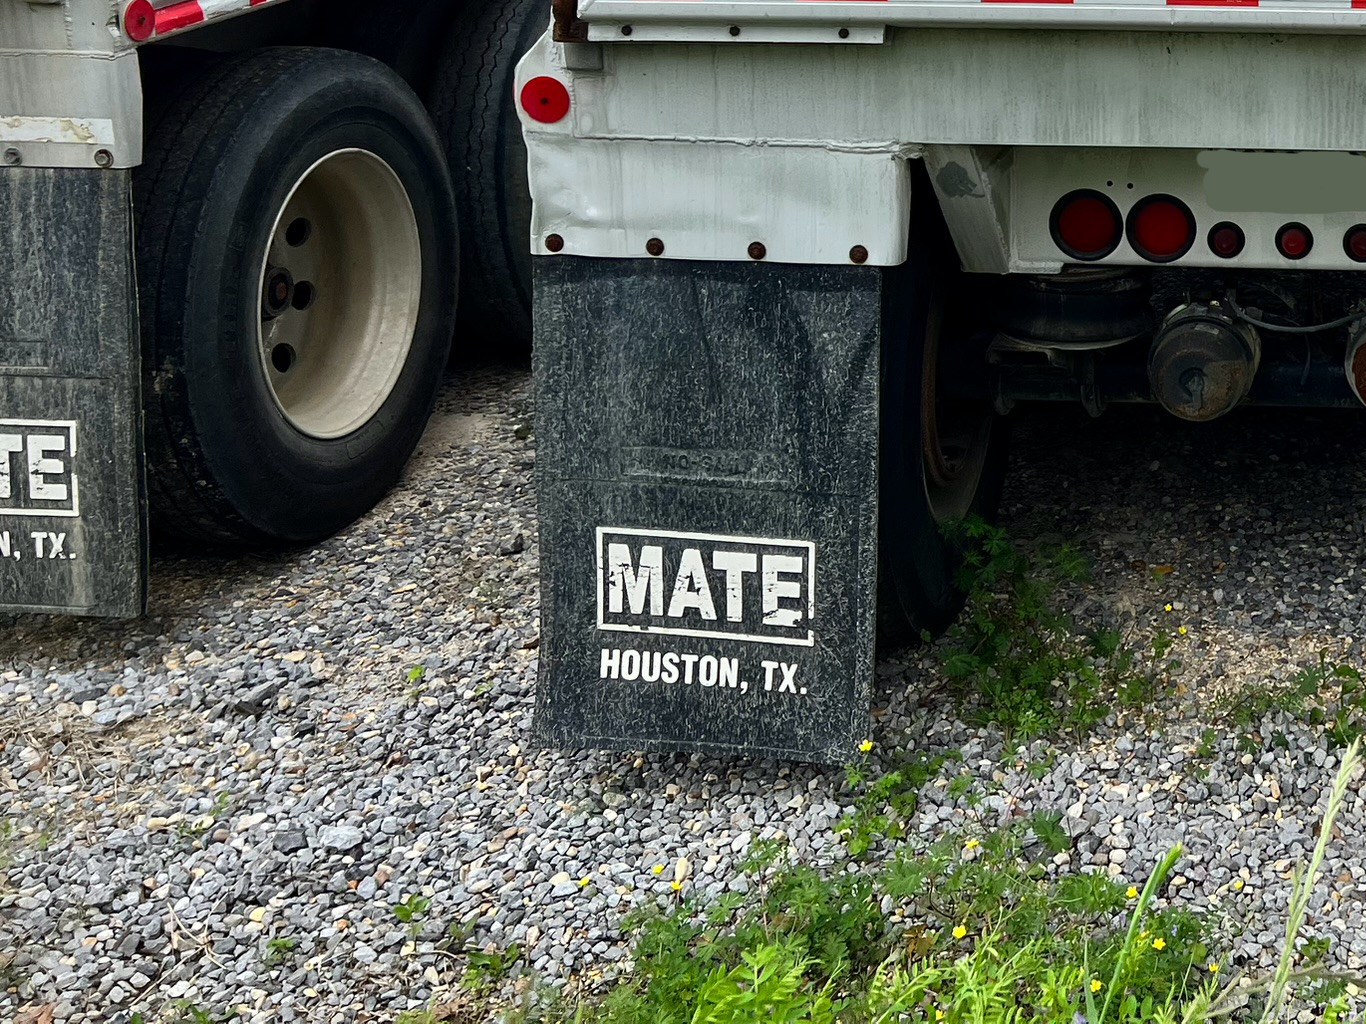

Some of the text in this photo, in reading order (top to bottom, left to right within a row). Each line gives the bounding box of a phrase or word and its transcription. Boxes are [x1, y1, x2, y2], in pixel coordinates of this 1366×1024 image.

[31, 531, 77, 560] TX.
[608, 542, 803, 627] MATE
[600, 648, 808, 695] HOUSTON, TX.
